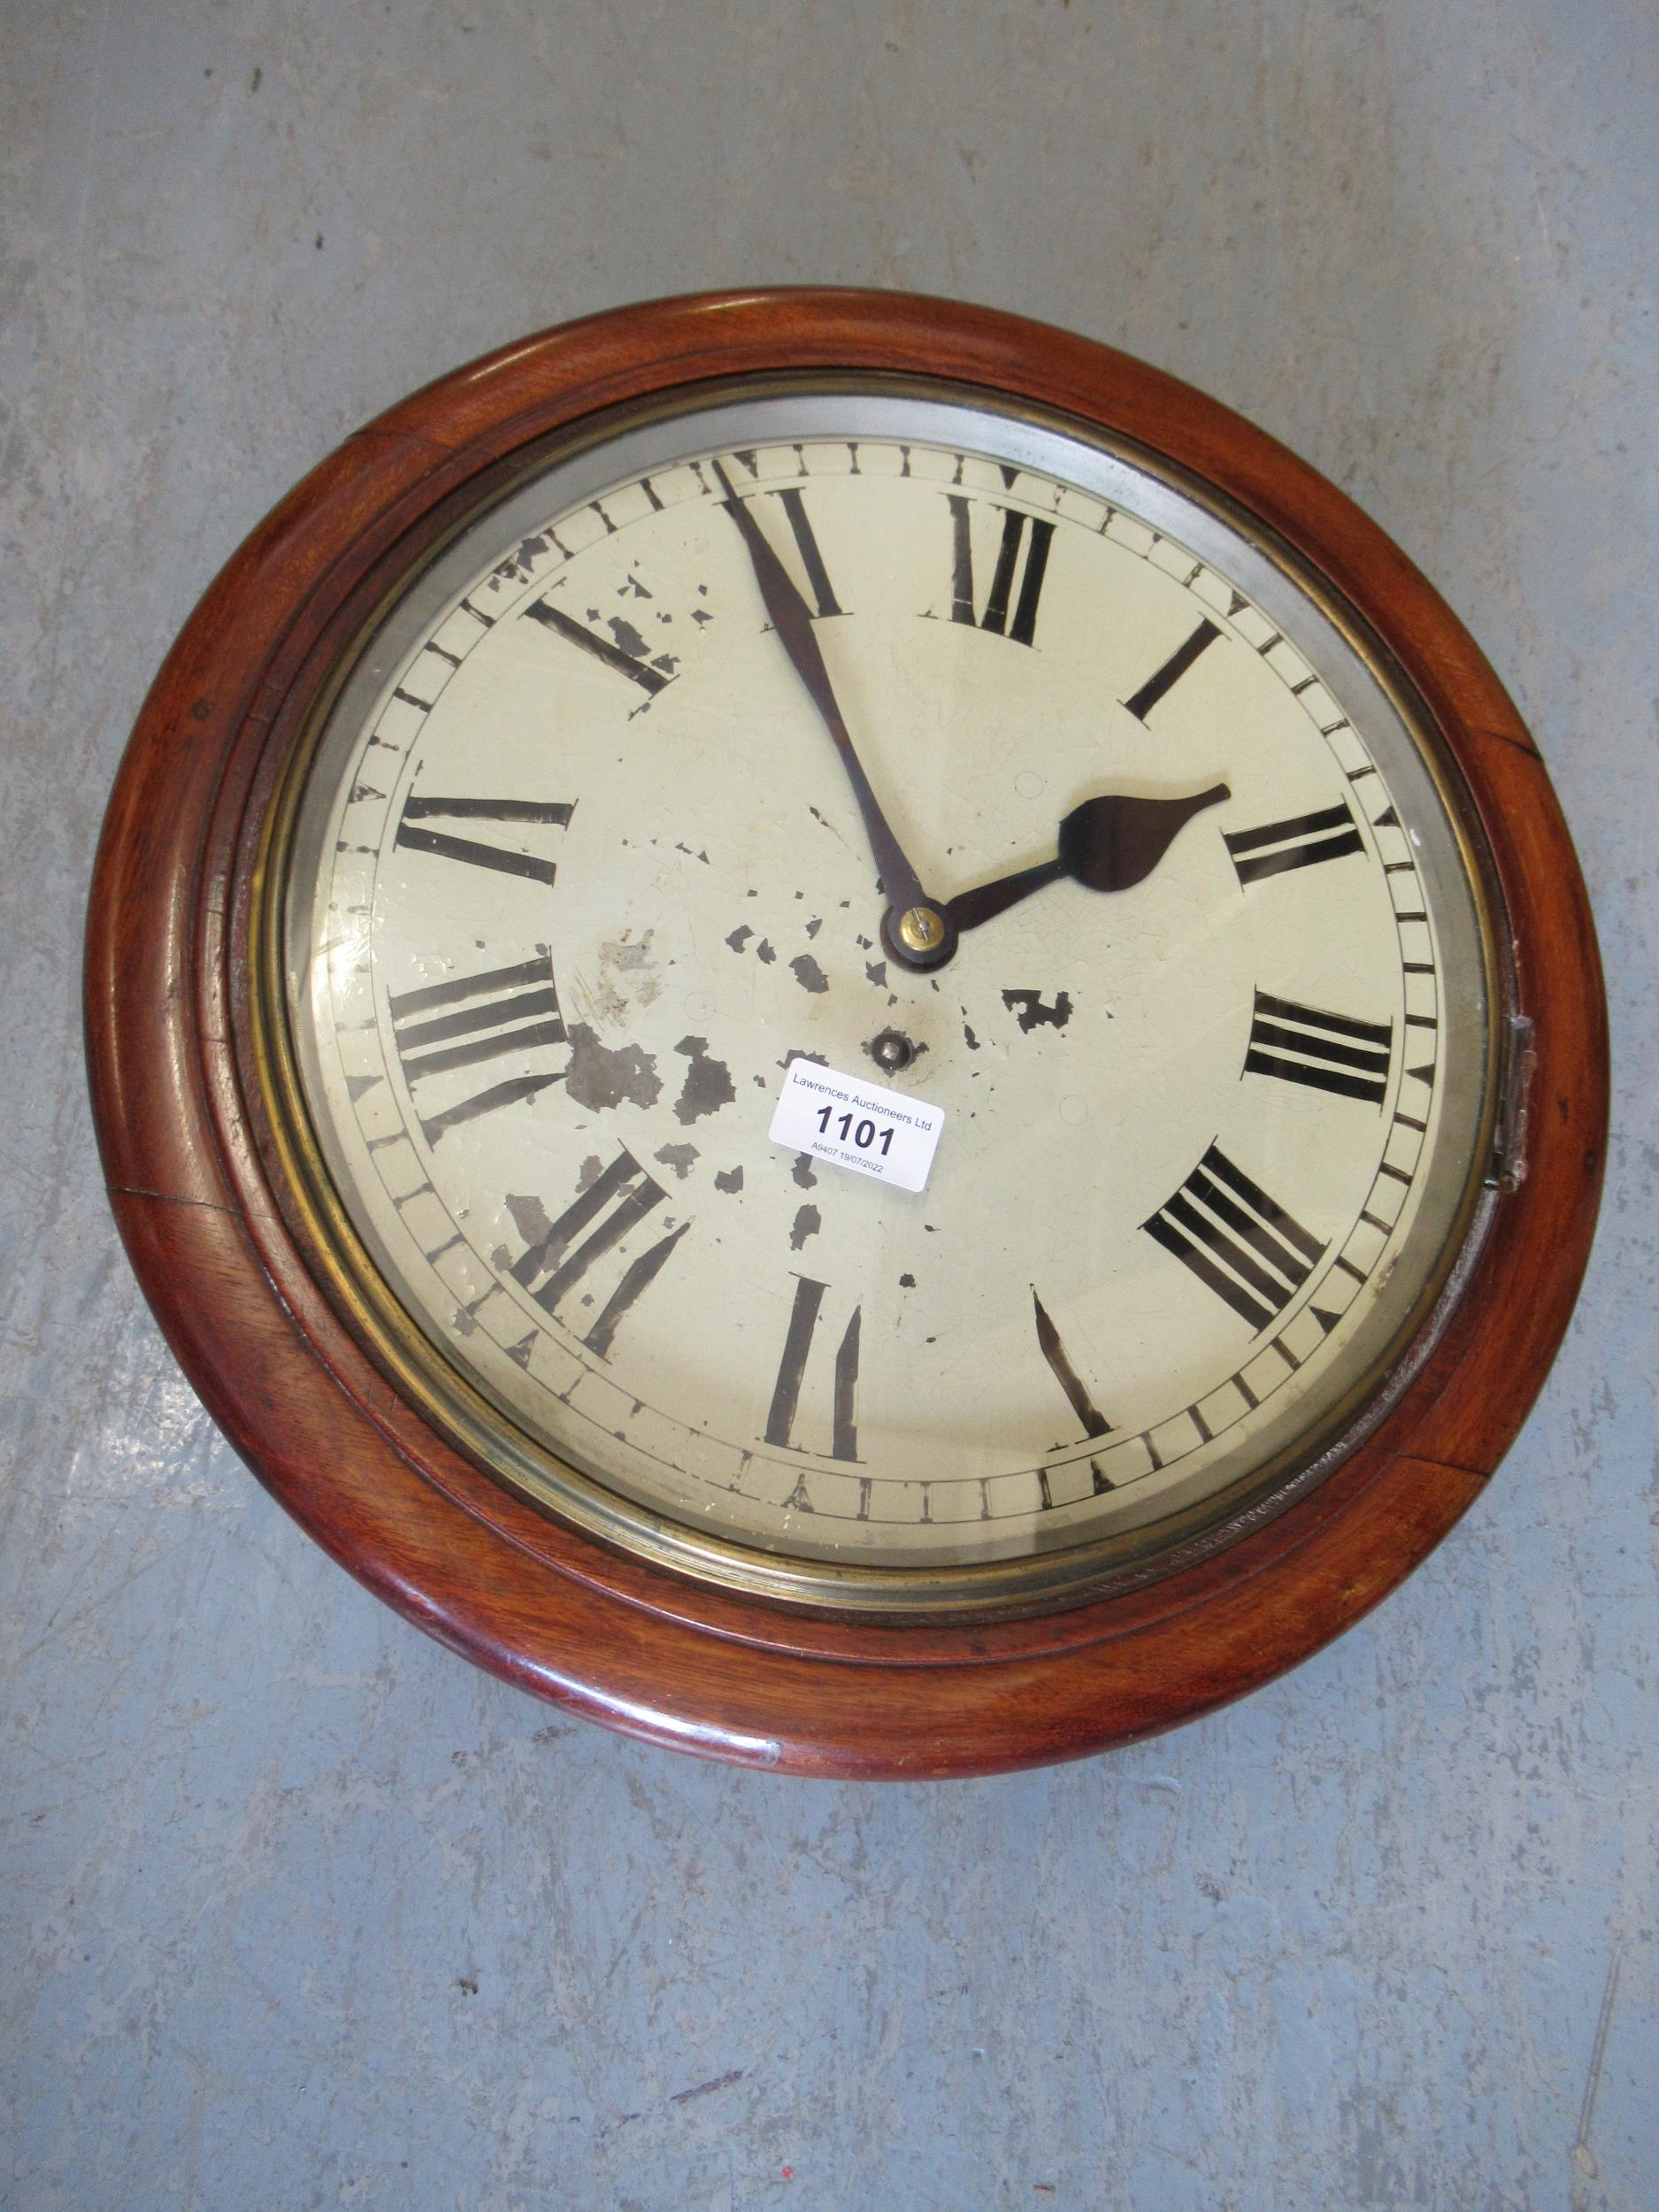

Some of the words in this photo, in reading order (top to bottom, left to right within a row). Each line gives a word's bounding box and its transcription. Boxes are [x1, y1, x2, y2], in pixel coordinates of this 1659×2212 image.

[1116, 611, 1233, 731] I
[1219, 793, 1370, 895] II
[1240, 983, 1394, 1117] III
[793, 1073, 849, 1102] Lawrences
[850, 1094, 912, 1125] Auctioneers
[914, 1118, 933, 1132] Ltd
[817, 1105, 895, 1156] 1101
[811, 1141, 838, 1156] A9407
[840, 1151, 884, 1173] 19/07/2022
[1137, 1134, 1333, 1343] IIII
